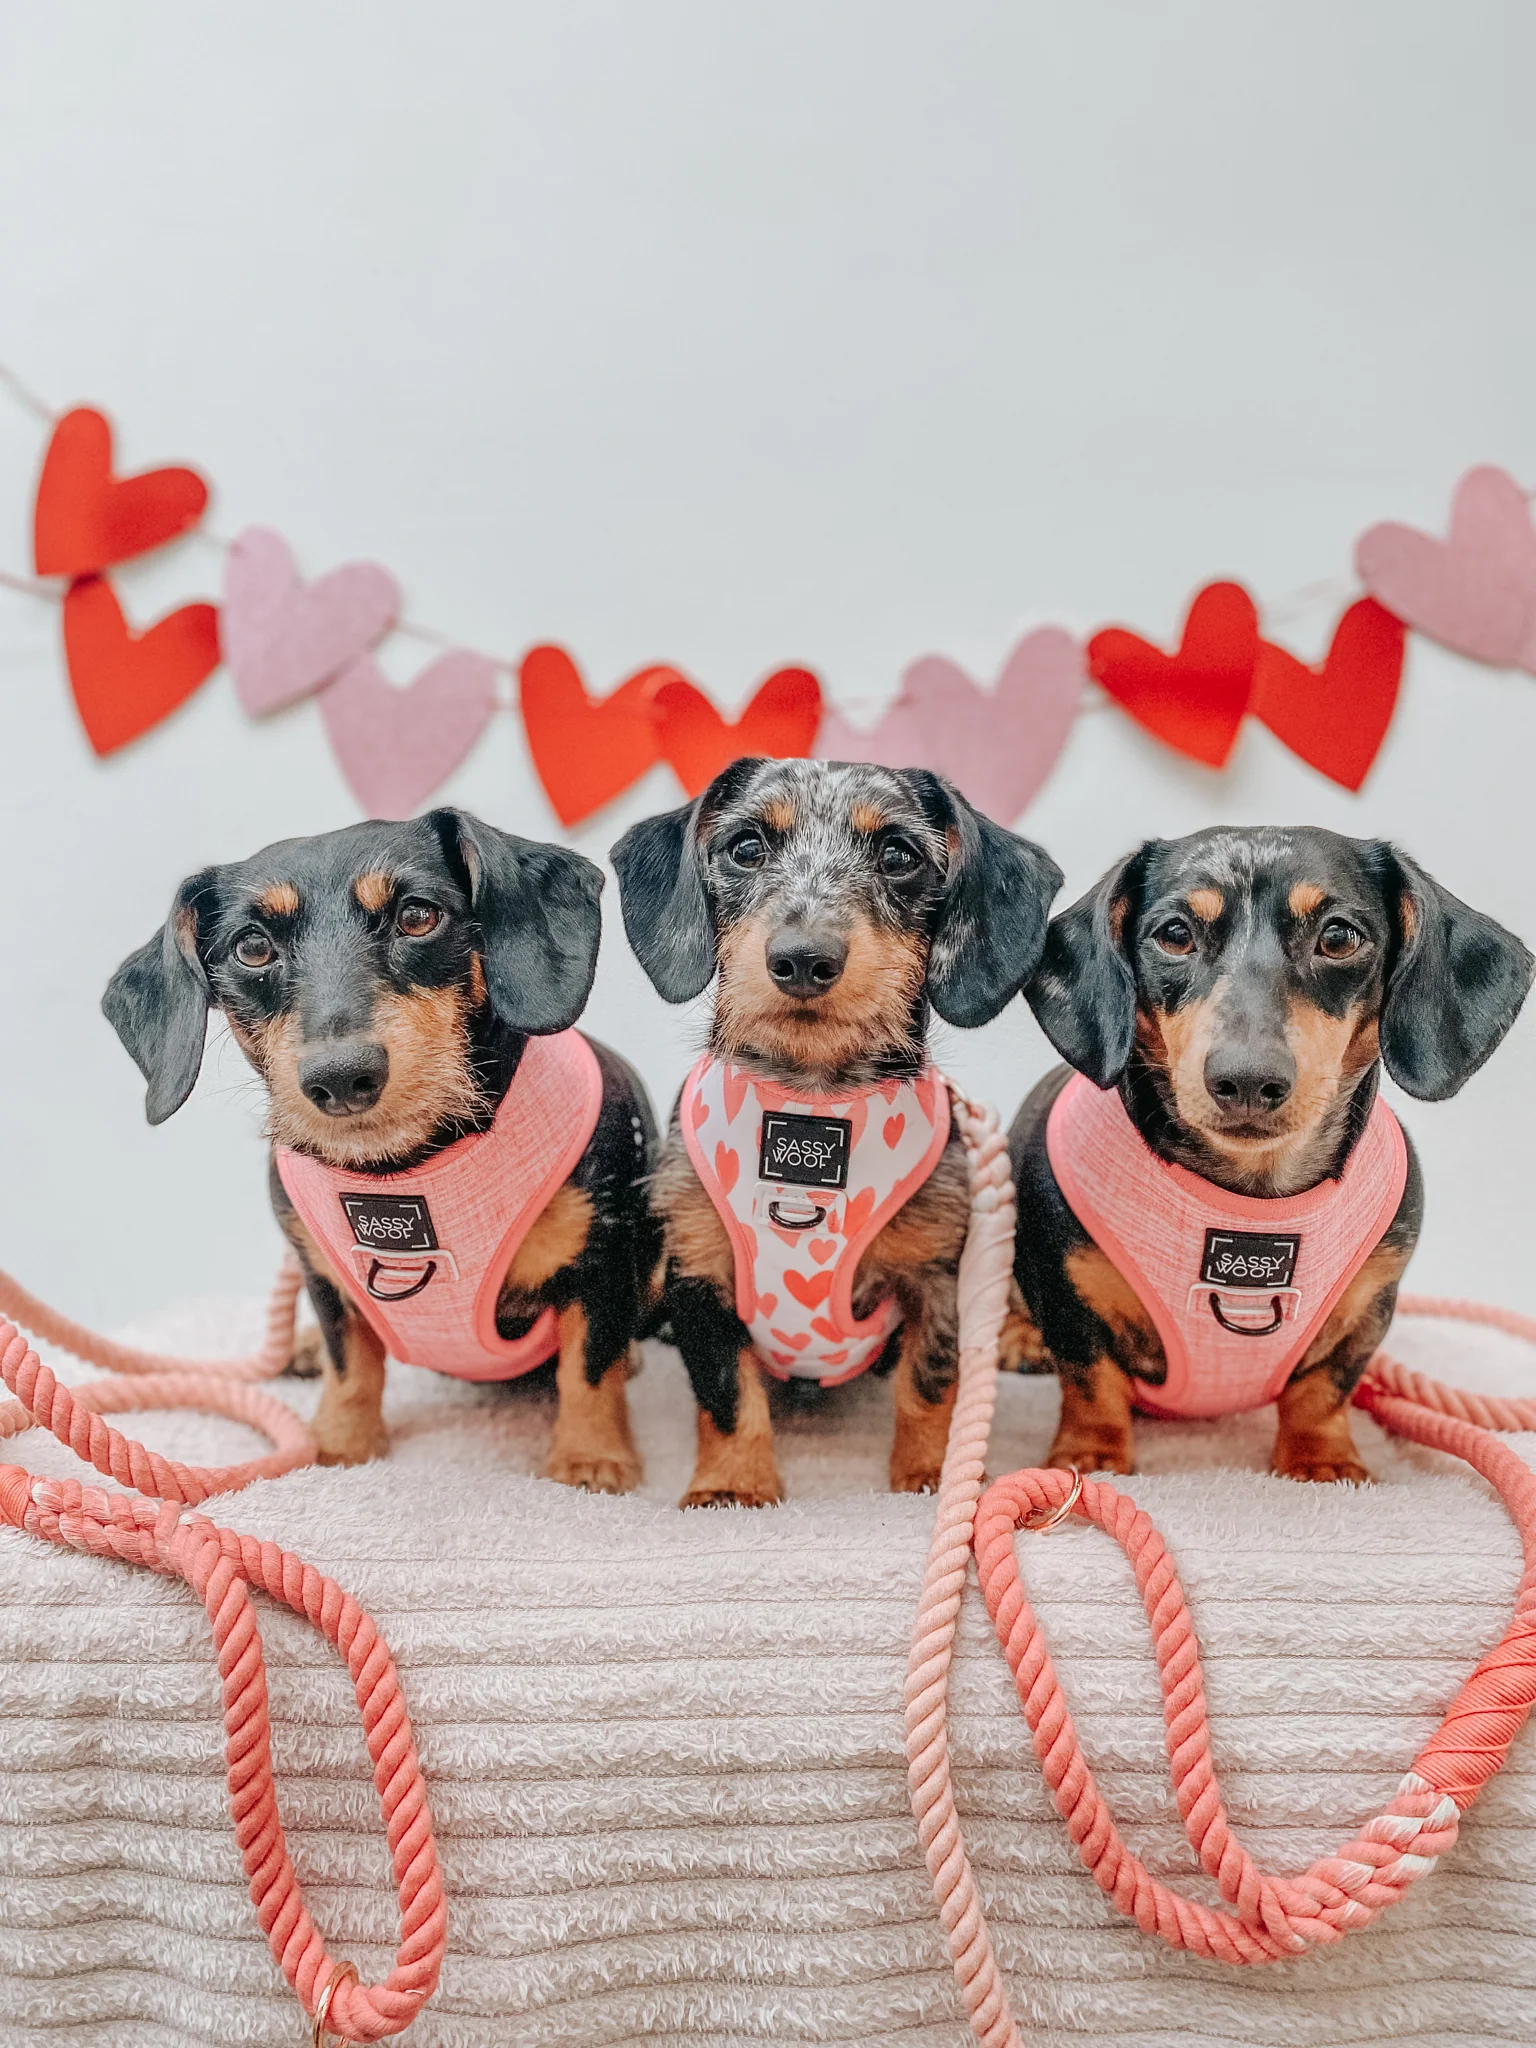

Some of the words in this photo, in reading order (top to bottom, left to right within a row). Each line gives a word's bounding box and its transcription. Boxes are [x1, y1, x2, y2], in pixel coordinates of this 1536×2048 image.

[776, 1137, 836, 1156] SASSY
[772, 1149, 832, 1169] WOOF
[358, 1215, 414, 1230] SASSY
[357, 1223, 414, 1239] WOOF
[1221, 1253, 1285, 1269] SASSY
[1216, 1261, 1280, 1278] WOOF
